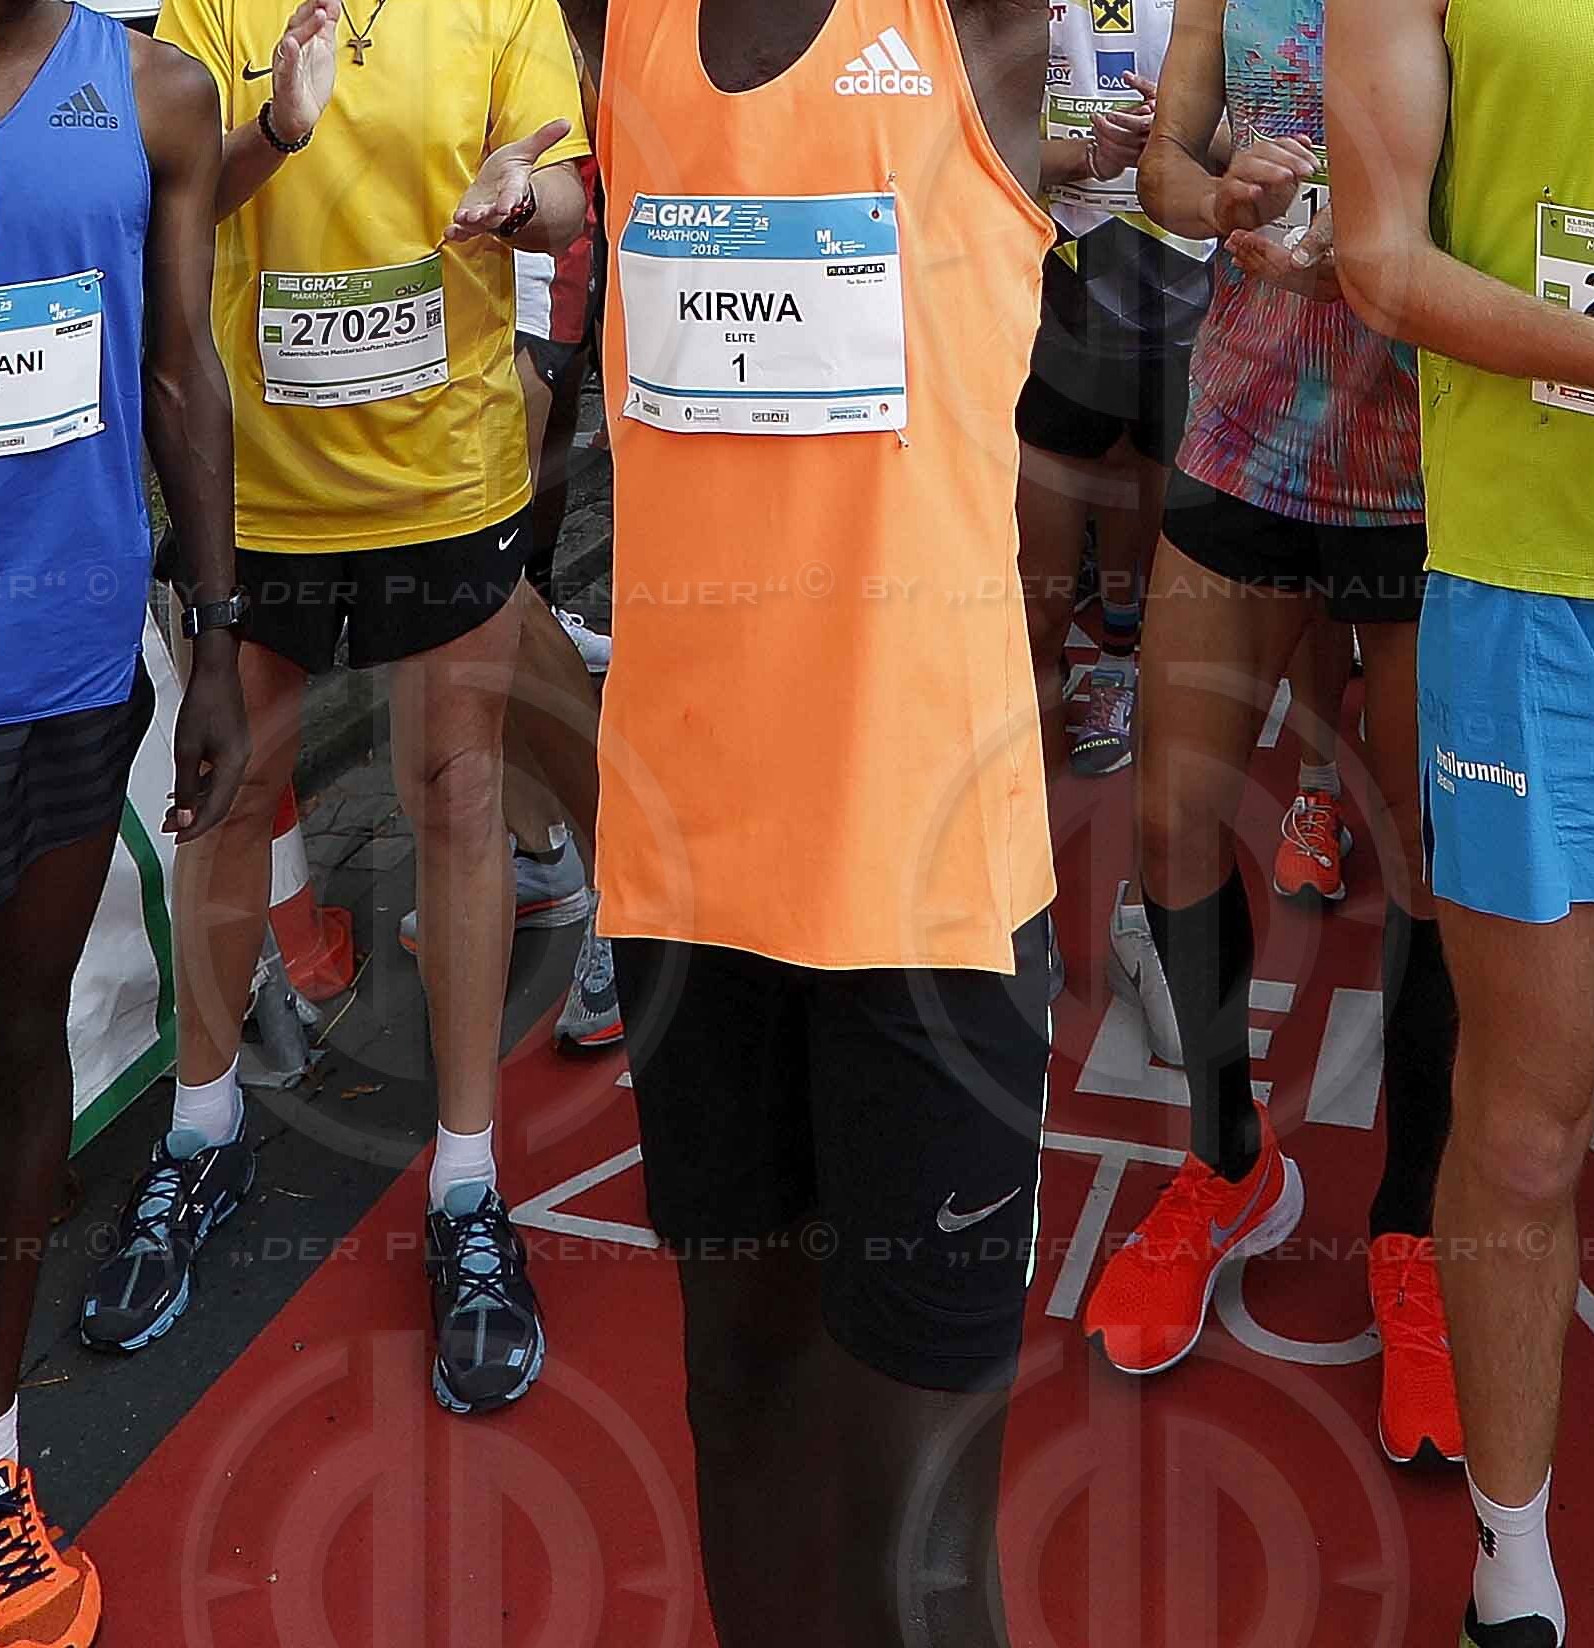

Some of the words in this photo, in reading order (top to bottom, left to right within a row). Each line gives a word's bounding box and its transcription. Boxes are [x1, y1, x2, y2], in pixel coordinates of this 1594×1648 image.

[833, 69, 934, 96] adidas
[1075, 100, 1113, 113] GRAZ
[48, 109, 119, 129] adidas
[659, 205, 731, 227] GRAZ
[754, 217, 769, 228] 25
[647, 229, 709, 242] MARATHON
[691, 244, 720, 255] 2018
[302, 277, 348, 291] GRAZ
[292, 292, 335, 300] MARATHON
[679, 291, 803, 322] KIRWA
[291, 301, 416, 346] 27025
[725, 333, 756, 343] ELITE
[732, 353, 746, 383] 1
